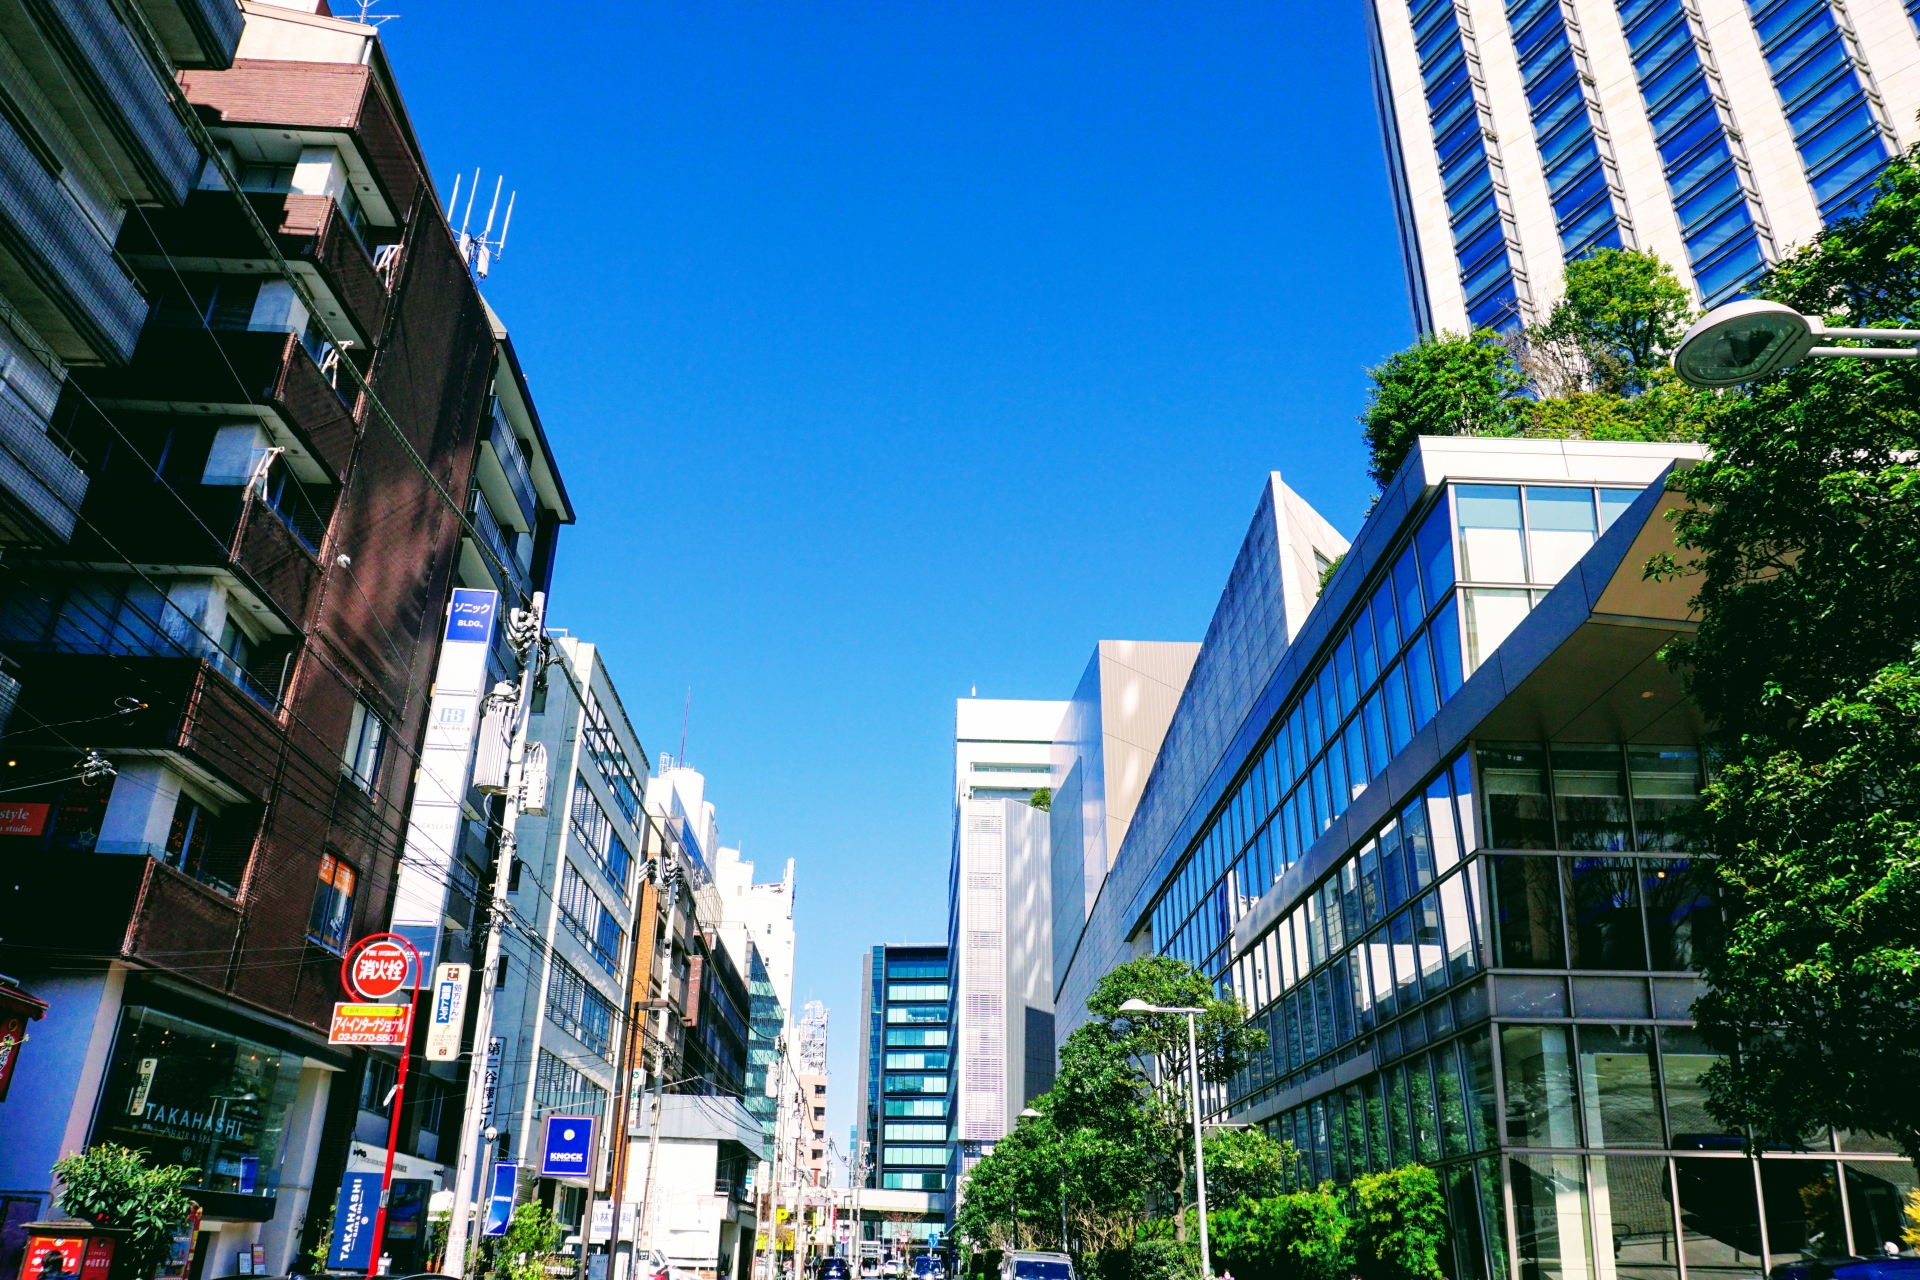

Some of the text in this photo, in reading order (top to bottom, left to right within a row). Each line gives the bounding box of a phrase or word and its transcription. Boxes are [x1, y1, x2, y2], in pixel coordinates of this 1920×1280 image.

[454, 603, 491, 614] ソニック
[5, 825, 32, 833] studio
[358, 959, 405, 980] 消火栓
[338, 1033, 398, 1042] 03-5770-5501
[146, 1102, 243, 1139] TAKAHASHI
[550, 1152, 584, 1160] KNOCK
[339, 1179, 363, 1261] TAKAHASHI
[591, 1211, 632, 1224] 小林科
